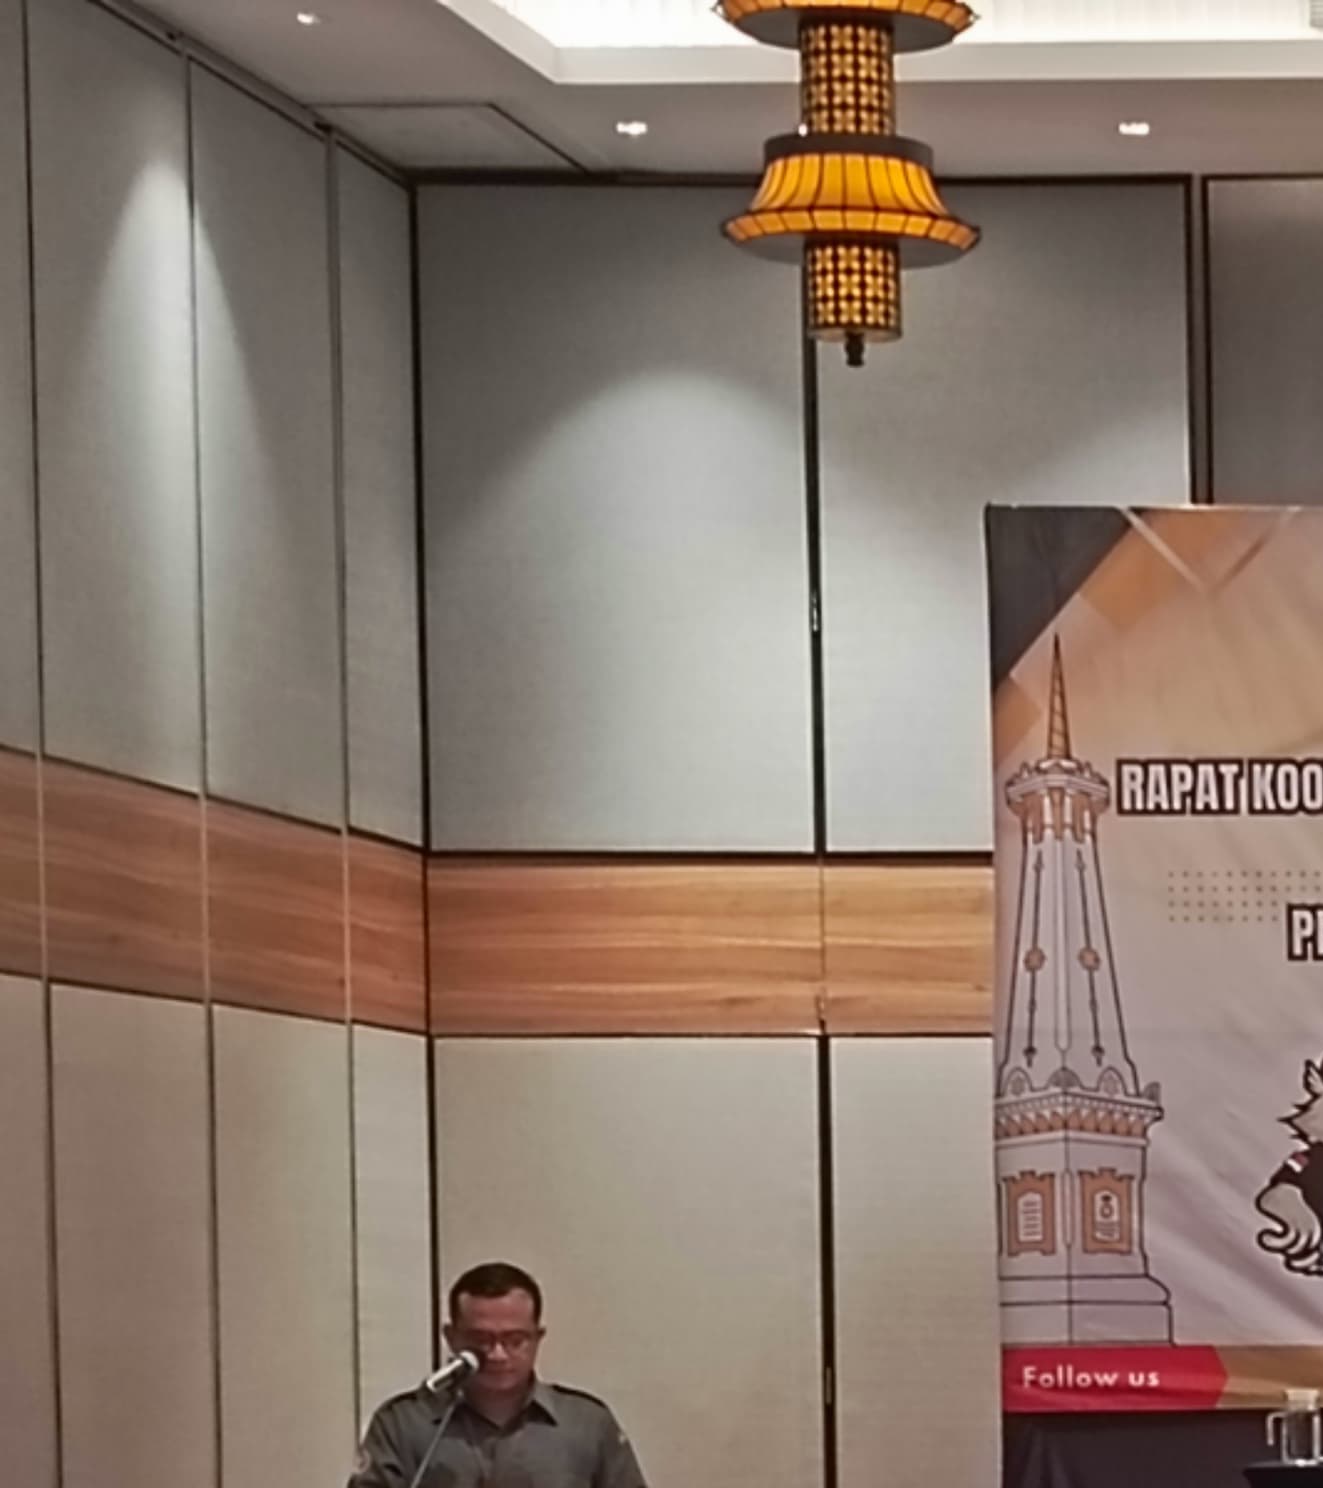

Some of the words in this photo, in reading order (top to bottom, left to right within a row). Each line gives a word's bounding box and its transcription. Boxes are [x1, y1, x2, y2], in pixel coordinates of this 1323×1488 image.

[1118, 761, 1242, 813] RAPAT
[1022, 1363, 1119, 1389] Follow
[1128, 1371, 1160, 1387] us
